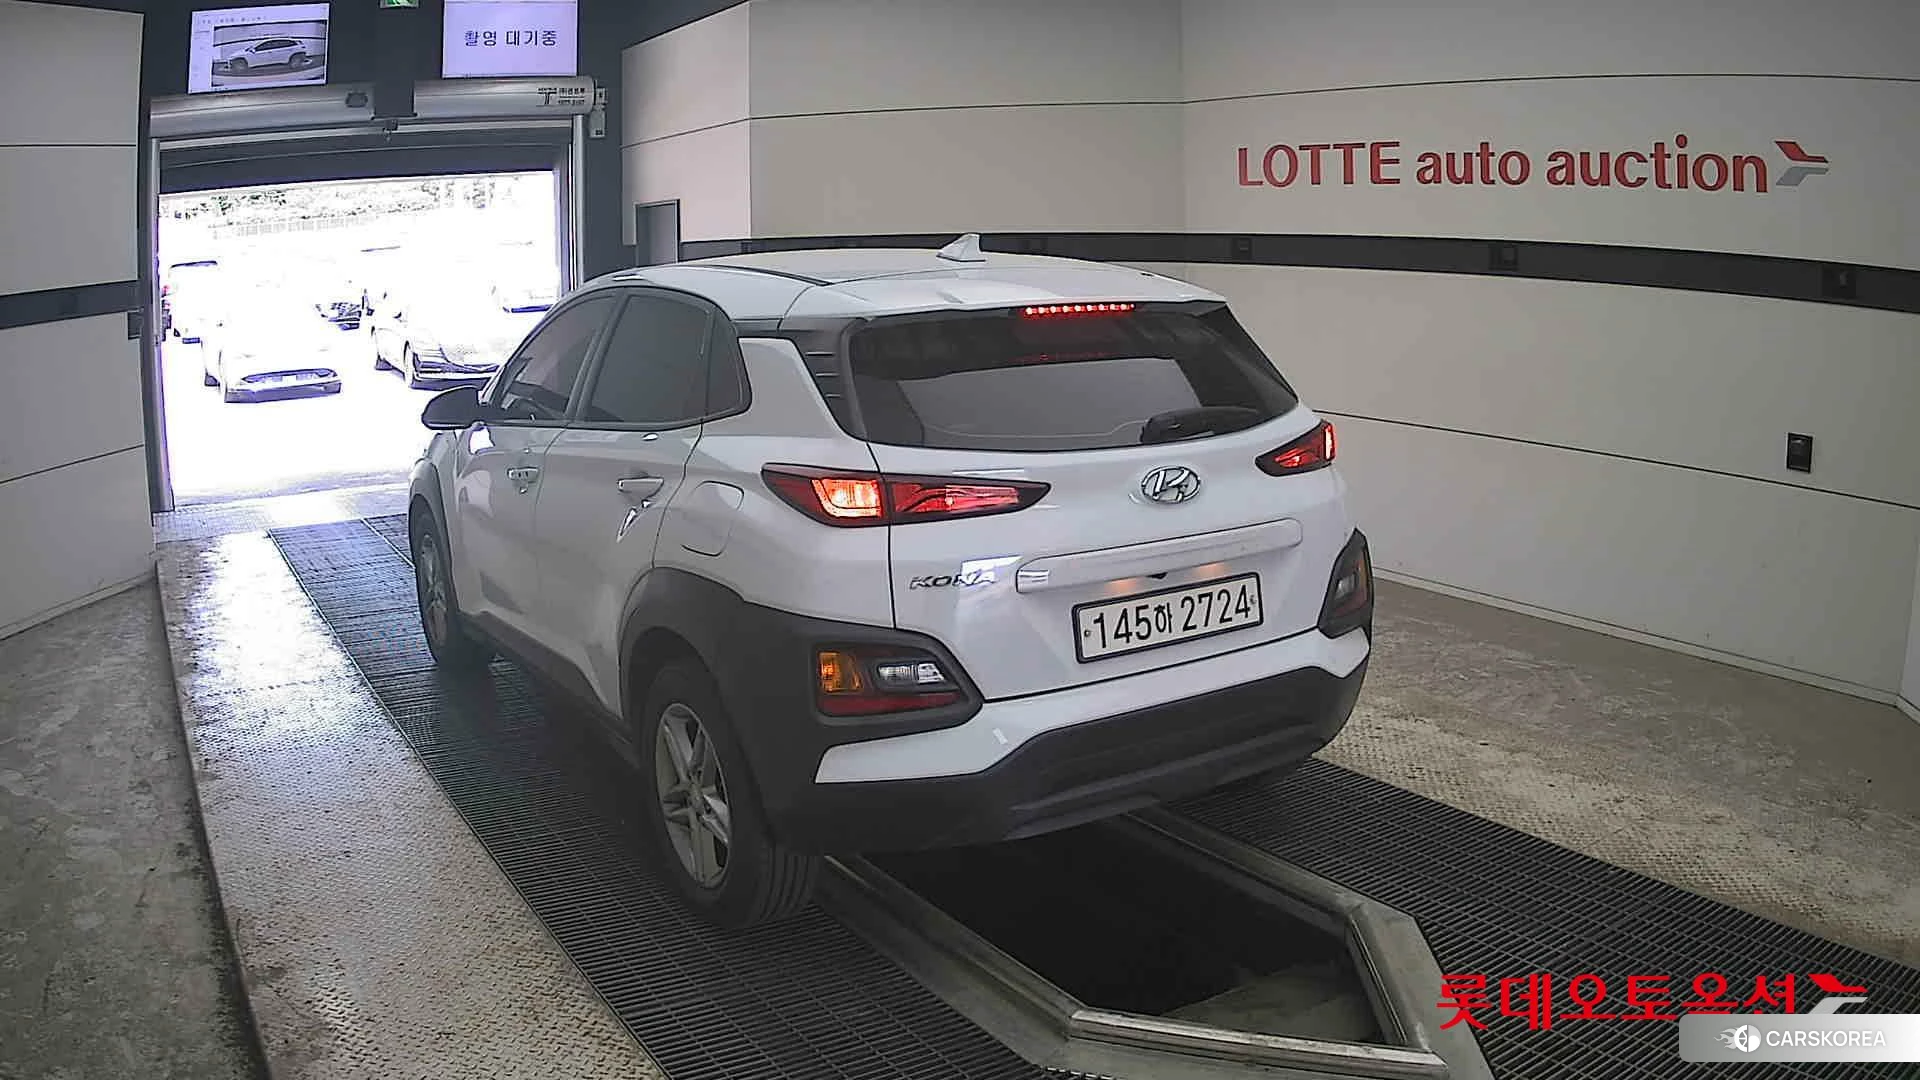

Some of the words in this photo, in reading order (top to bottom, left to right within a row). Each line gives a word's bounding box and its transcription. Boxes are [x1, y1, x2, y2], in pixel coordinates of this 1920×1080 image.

[506, 30, 557, 46] 대기중
[1237, 141, 1401, 187] LOTTE
[1416, 142, 1530, 185] auto
[1546, 135, 1768, 193] auction
[910, 570, 997, 590] KONA
